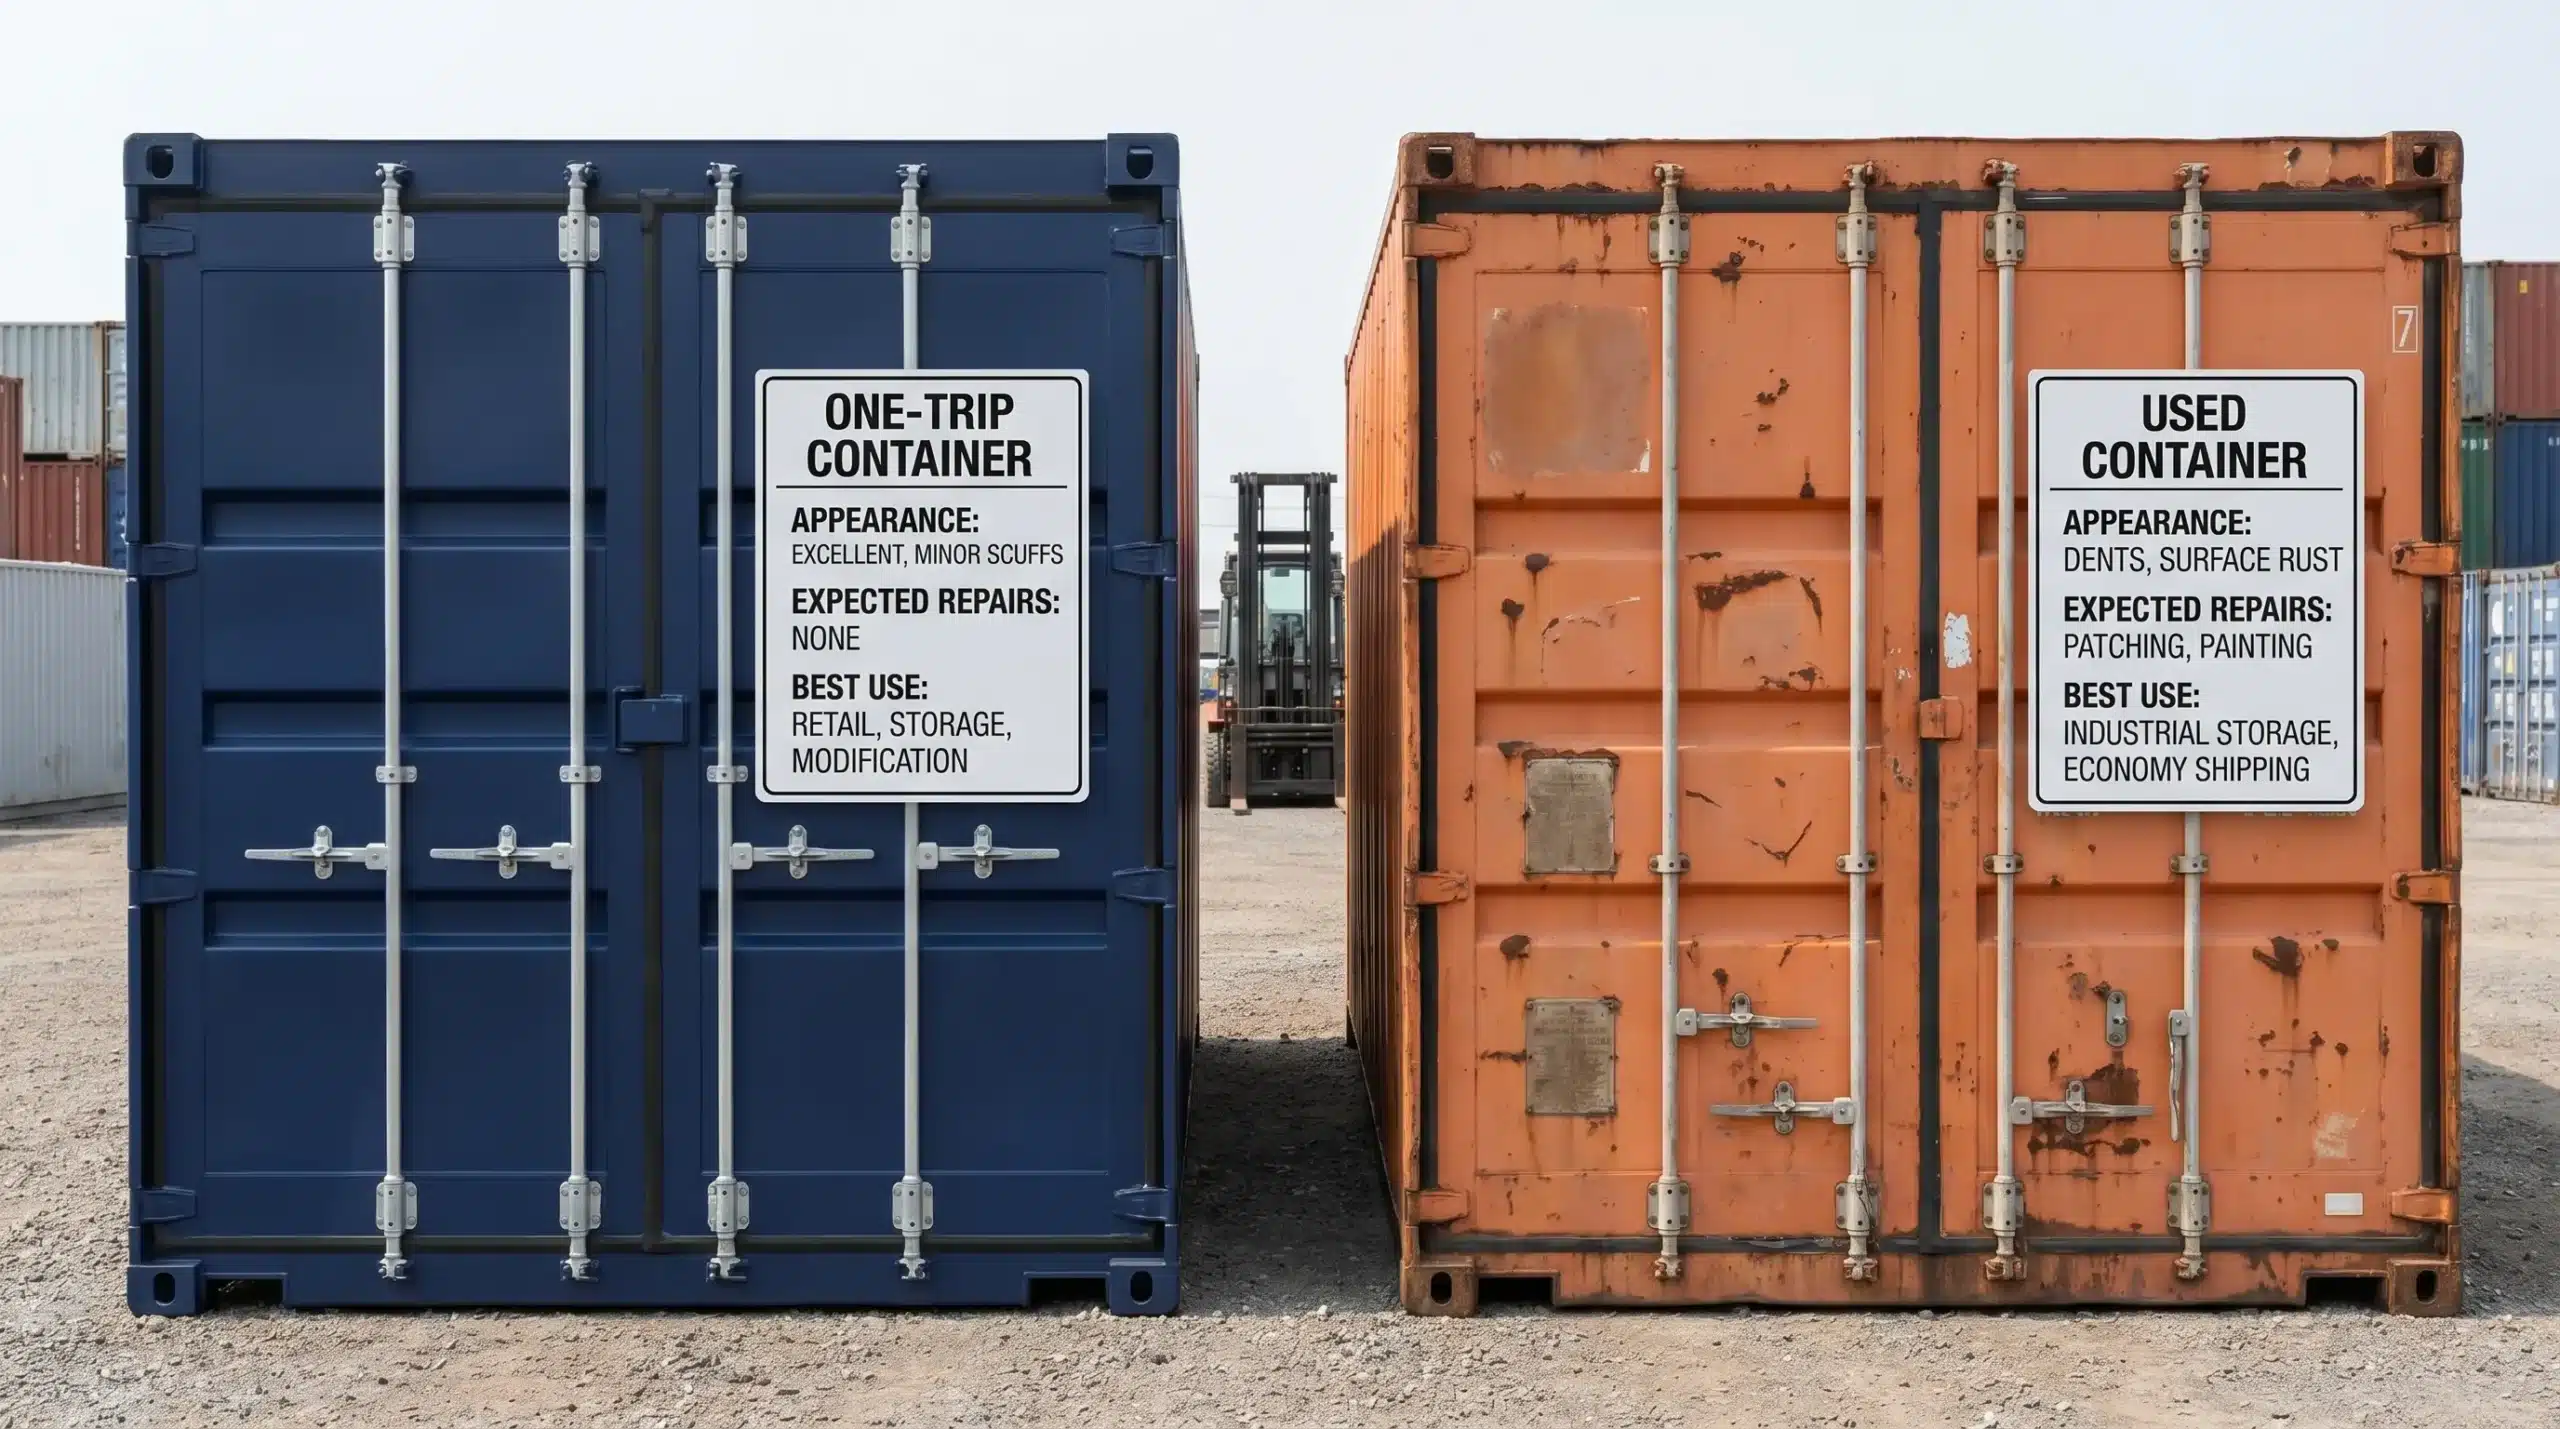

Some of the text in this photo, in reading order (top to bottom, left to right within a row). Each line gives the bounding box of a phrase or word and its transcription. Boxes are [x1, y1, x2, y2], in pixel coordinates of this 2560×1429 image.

[2397, 310, 2414, 348] 7
[825, 392, 1015, 431] ONE-TRIP
[2142, 393, 2246, 433] USED
[807, 438, 1033, 478] CONTAINER
[2082, 440, 2308, 480] CONTAINER
[790, 506, 979, 534] APPEARANCE:
[2062, 508, 2251, 536] APPEARANCE:
[792, 543, 1064, 568] EXCELLENT, MINOR SCUFFS
[2064, 546, 2344, 577] DENTS, SURFACE RUST
[792, 587, 1060, 615] EXPECTED REPAIRS:
[2064, 595, 2332, 623] EXPECTED REPAIRS:
[792, 625, 861, 651] NONE
[2064, 632, 2313, 664] PATCHING, PAINTING
[792, 673, 928, 701] BEST USE:
[2064, 681, 2200, 709] BEST USE:
[792, 710, 1012, 742] RETAIL, STORAGE,
[2064, 719, 2338, 750] INDUSTRIAL STORAGE,
[792, 747, 968, 774] MODIFICATION
[2064, 755, 2310, 783] ECONOMY SHIPPING
